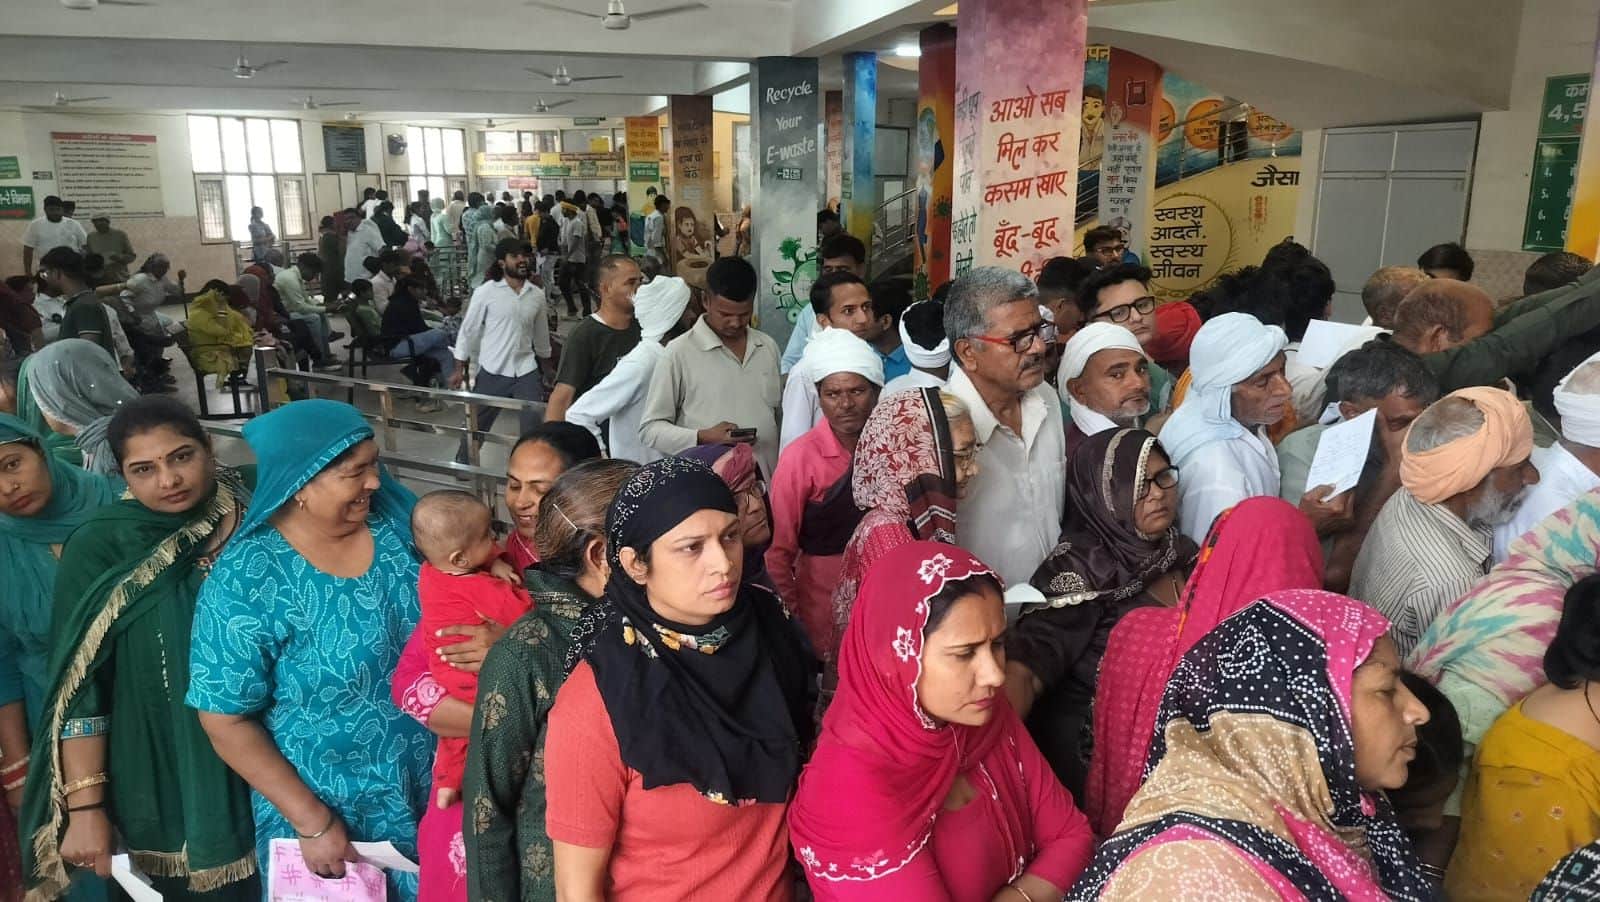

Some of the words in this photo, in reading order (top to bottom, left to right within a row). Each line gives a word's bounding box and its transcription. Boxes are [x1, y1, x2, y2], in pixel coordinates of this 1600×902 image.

[766, 81, 813, 104] Recycle
[990, 86, 1036, 123] आओ
[1040, 89, 1070, 116] सब
[776, 115, 802, 131] Your
[766, 136, 815, 164] E-waste
[997, 132, 1028, 170] मिल
[1032, 131, 1061, 157] कर
[1250, 164, 1301, 188] जैसा
[985, 177, 1033, 206] कसम
[1154, 206, 1206, 221] स्वस्थ
[1150, 244, 1207, 259] स्वस्थ
[1152, 259, 1202, 279] जीवन
